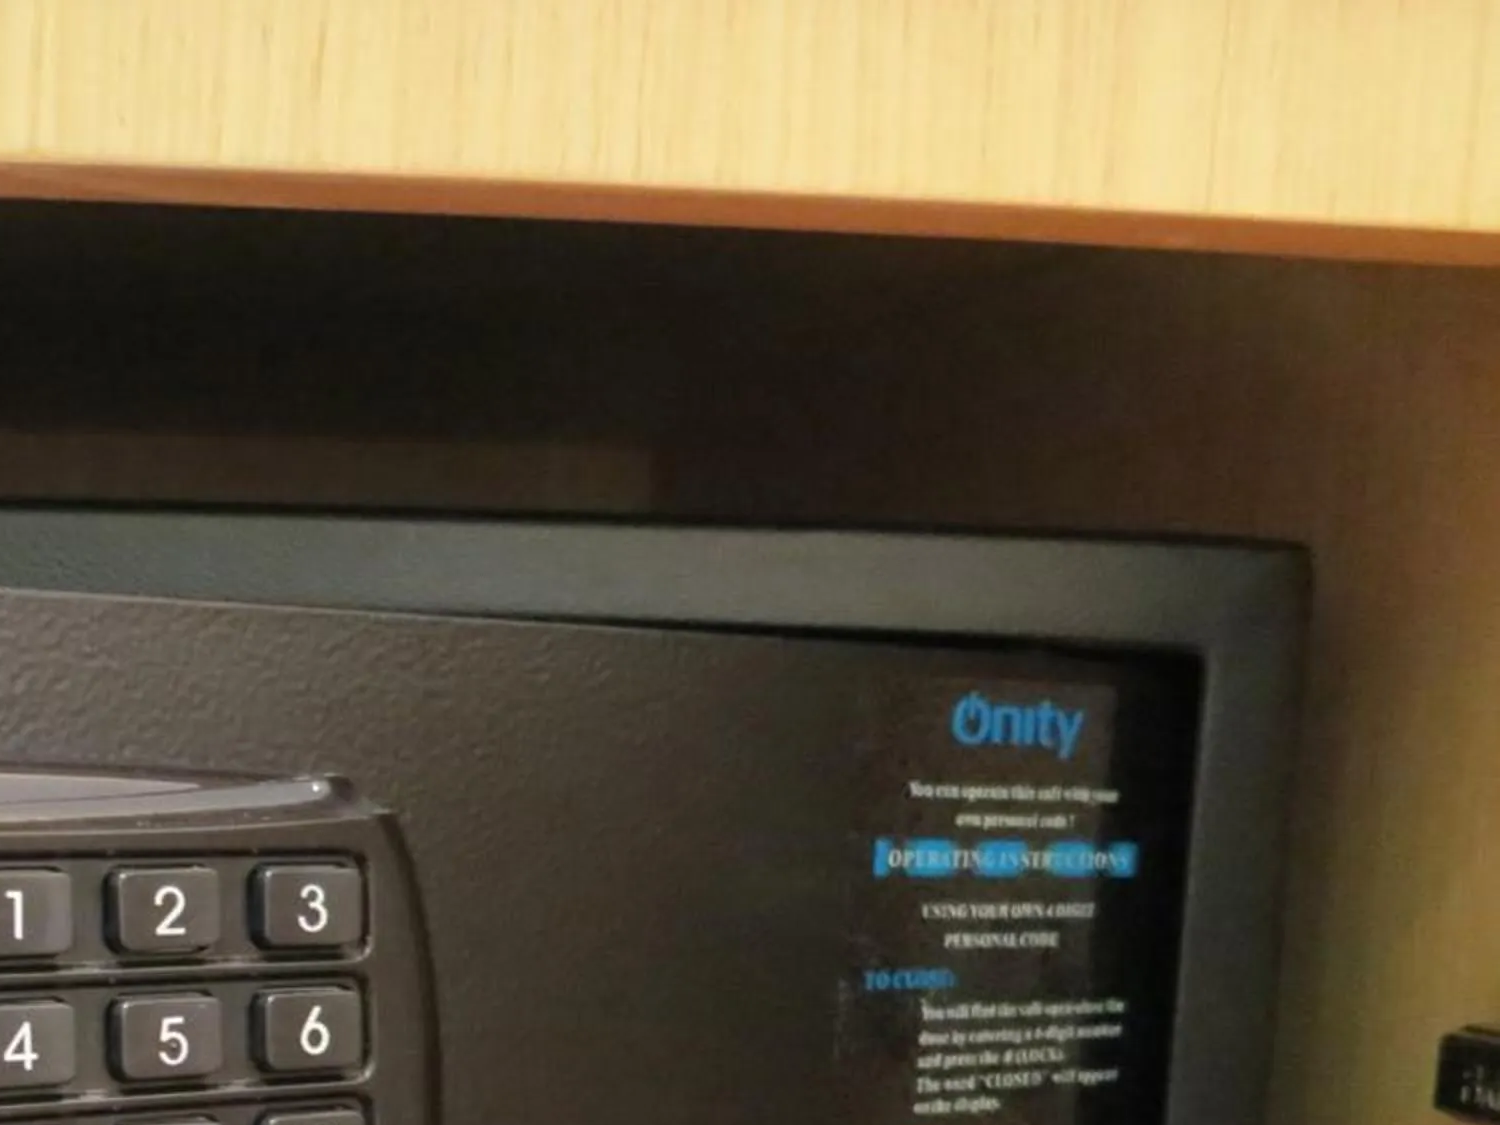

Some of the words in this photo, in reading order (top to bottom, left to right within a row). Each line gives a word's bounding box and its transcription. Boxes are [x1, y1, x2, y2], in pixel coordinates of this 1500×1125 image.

[952, 690, 1086, 759] Onity
[887, 848, 995, 870] OPERATING
[4, 889, 25, 940] 1
[153, 885, 188, 936] 2
[297, 884, 329, 933] 3
[2, 1020, 40, 1072] 4
[157, 1015, 190, 1066] 5
[300, 1004, 331, 1056] 6
